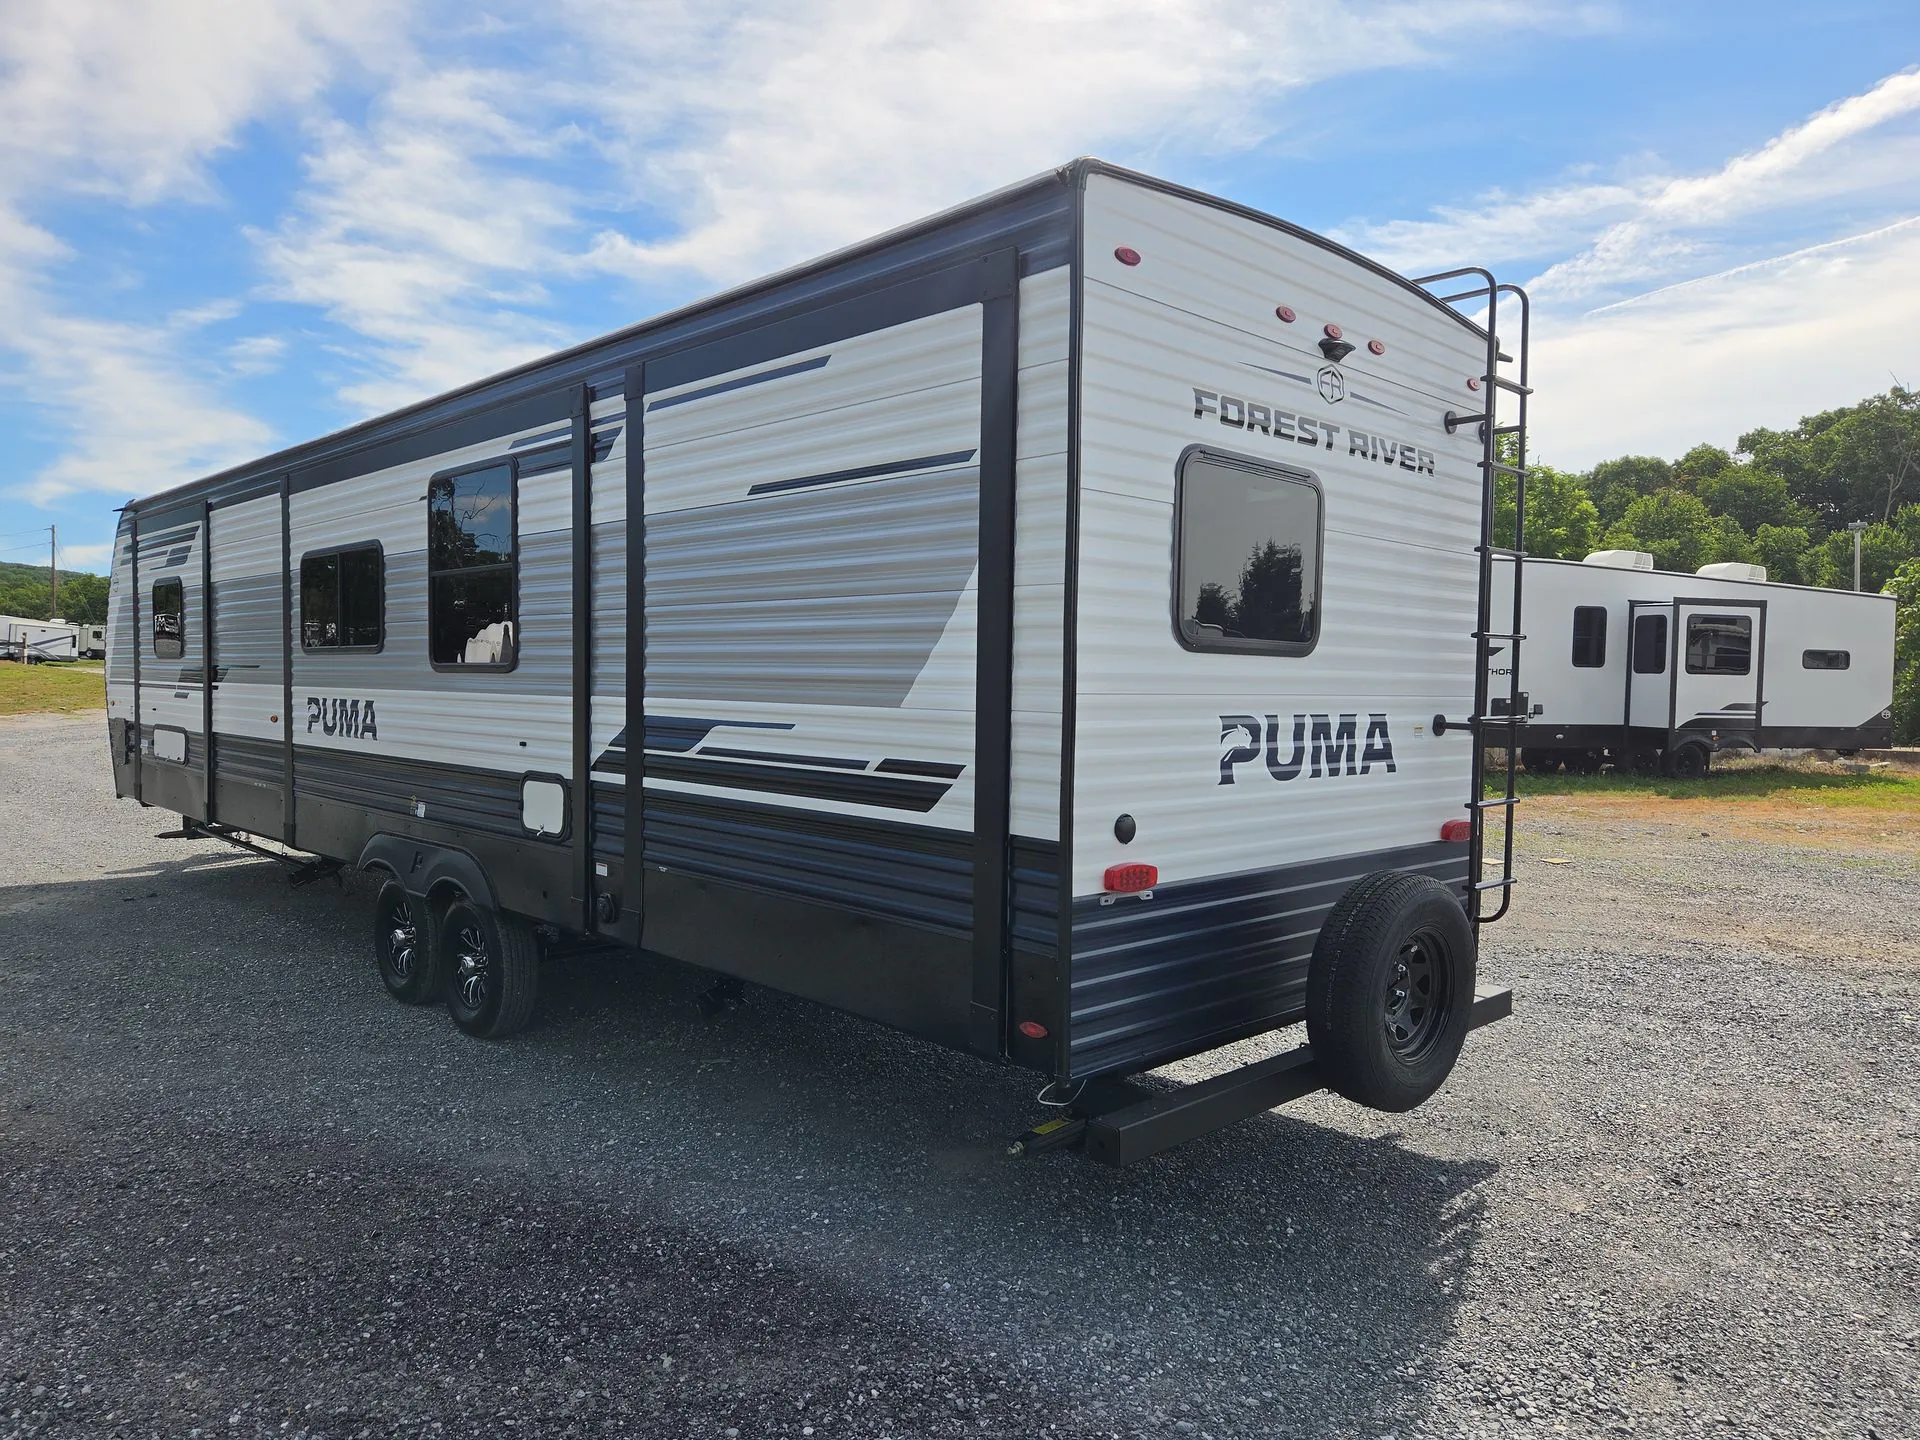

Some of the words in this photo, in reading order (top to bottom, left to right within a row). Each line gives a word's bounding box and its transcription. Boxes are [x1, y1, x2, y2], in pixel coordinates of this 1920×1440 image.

[1193, 388, 1340, 451] FOREST
[1348, 430, 1436, 477] RIVER
[307, 696, 378, 741] PUMA
[1218, 714, 1397, 785] PUMA
